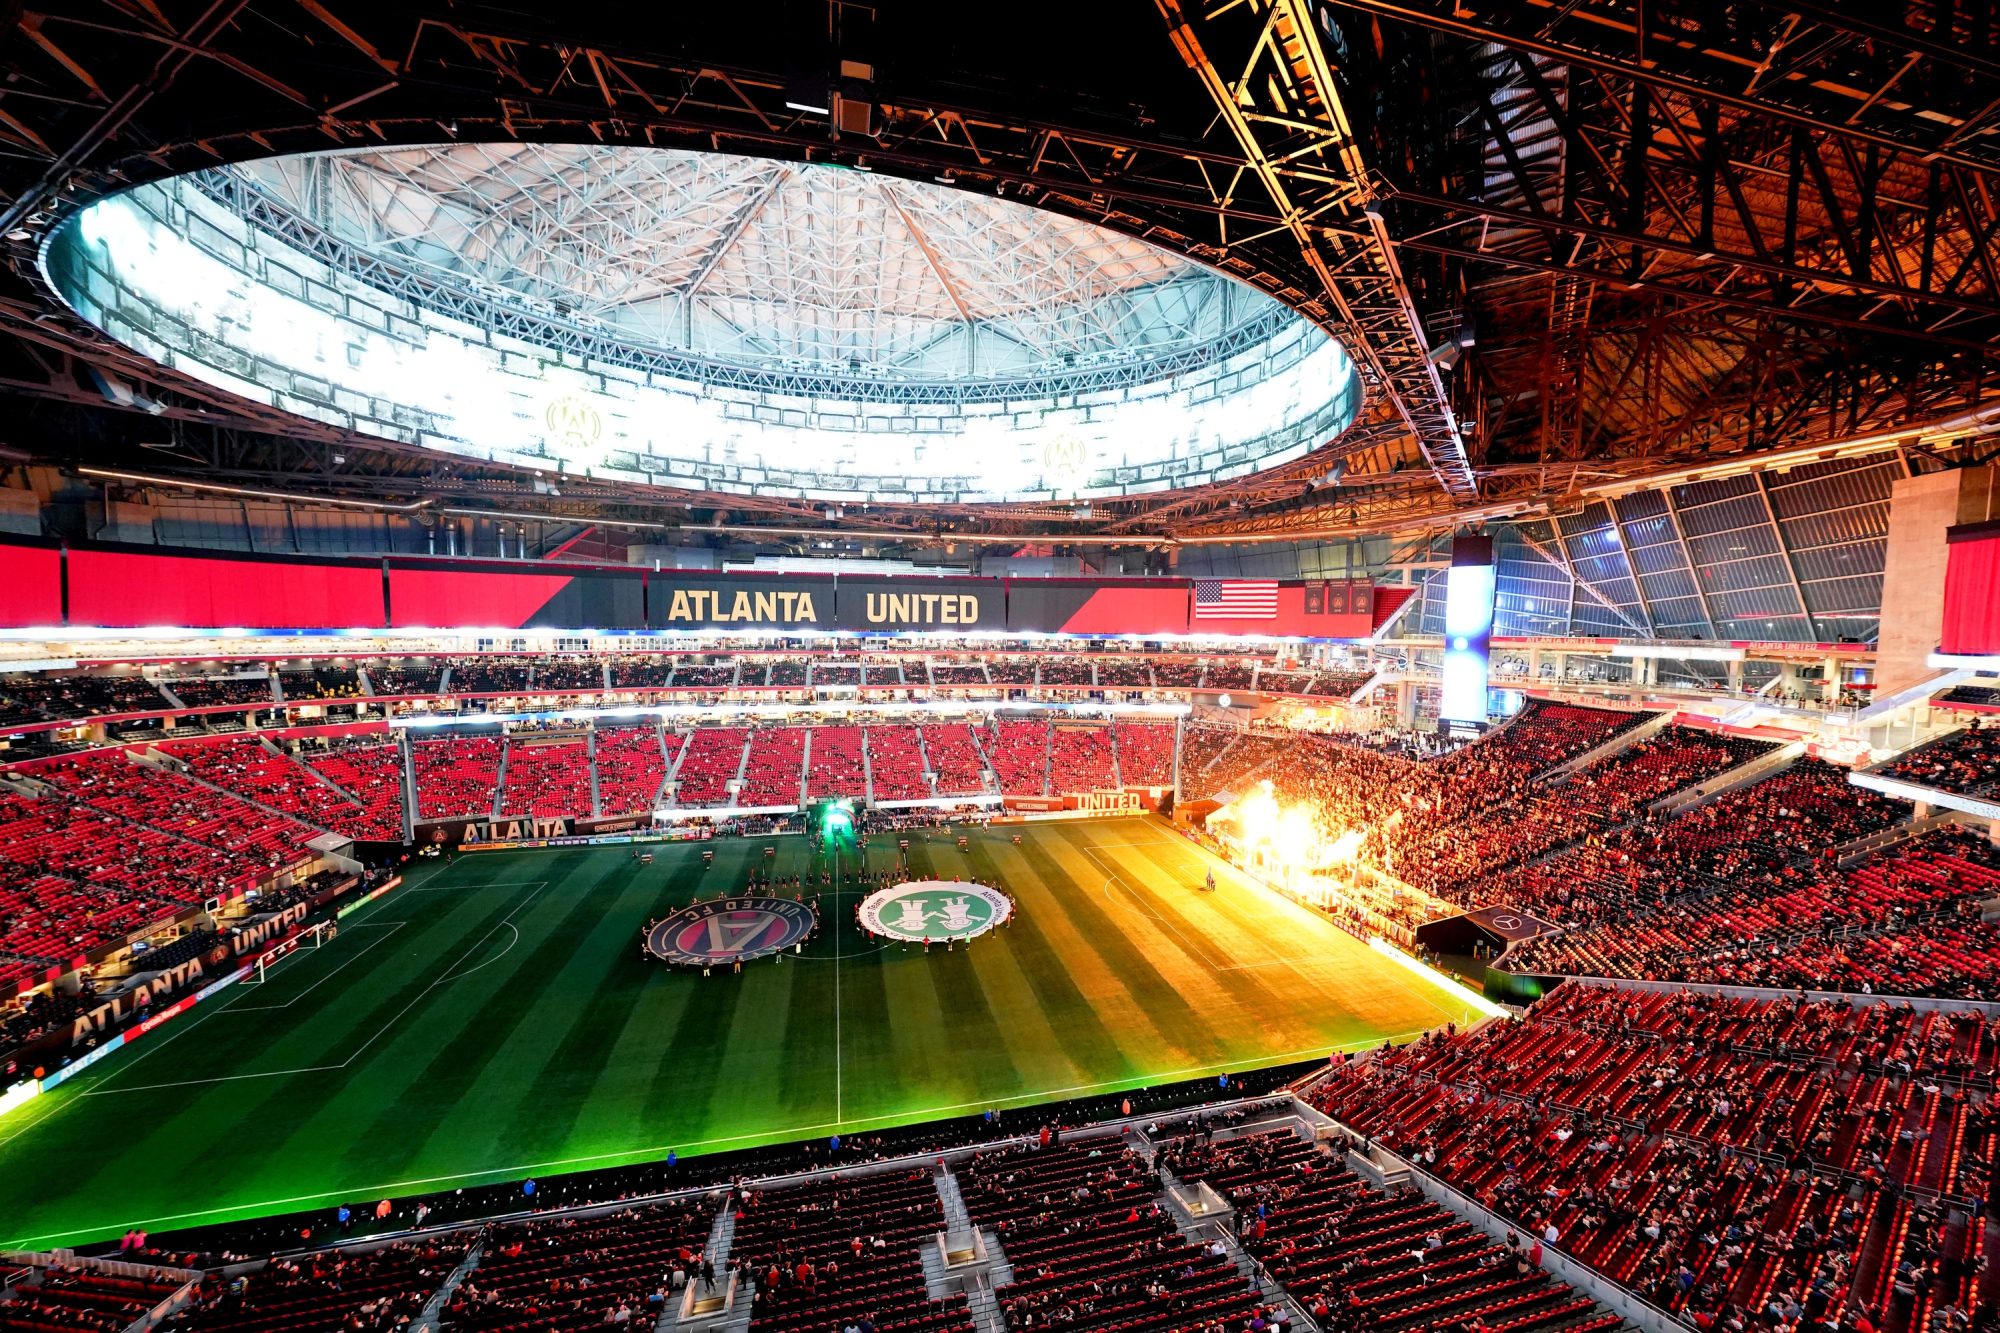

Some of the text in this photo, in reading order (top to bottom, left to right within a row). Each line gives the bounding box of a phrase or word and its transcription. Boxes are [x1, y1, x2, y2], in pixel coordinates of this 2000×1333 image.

[668, 590, 979, 623] ATLANTA UNITED
[1549, 692, 1583, 702] WELCOME
[1595, 697, 1610, 705] THE
[1611, 699, 1643, 708] GULCH
[1076, 792, 1141, 810] UNITED
[463, 818, 569, 843] ATLANTA
[725, 900, 801, 917] UNITED
[867, 897, 886, 910] Team
[685, 906, 715, 921] FC
[71, 956, 204, 1048] ATLANTA
[232, 902, 307, 956] UNITED
